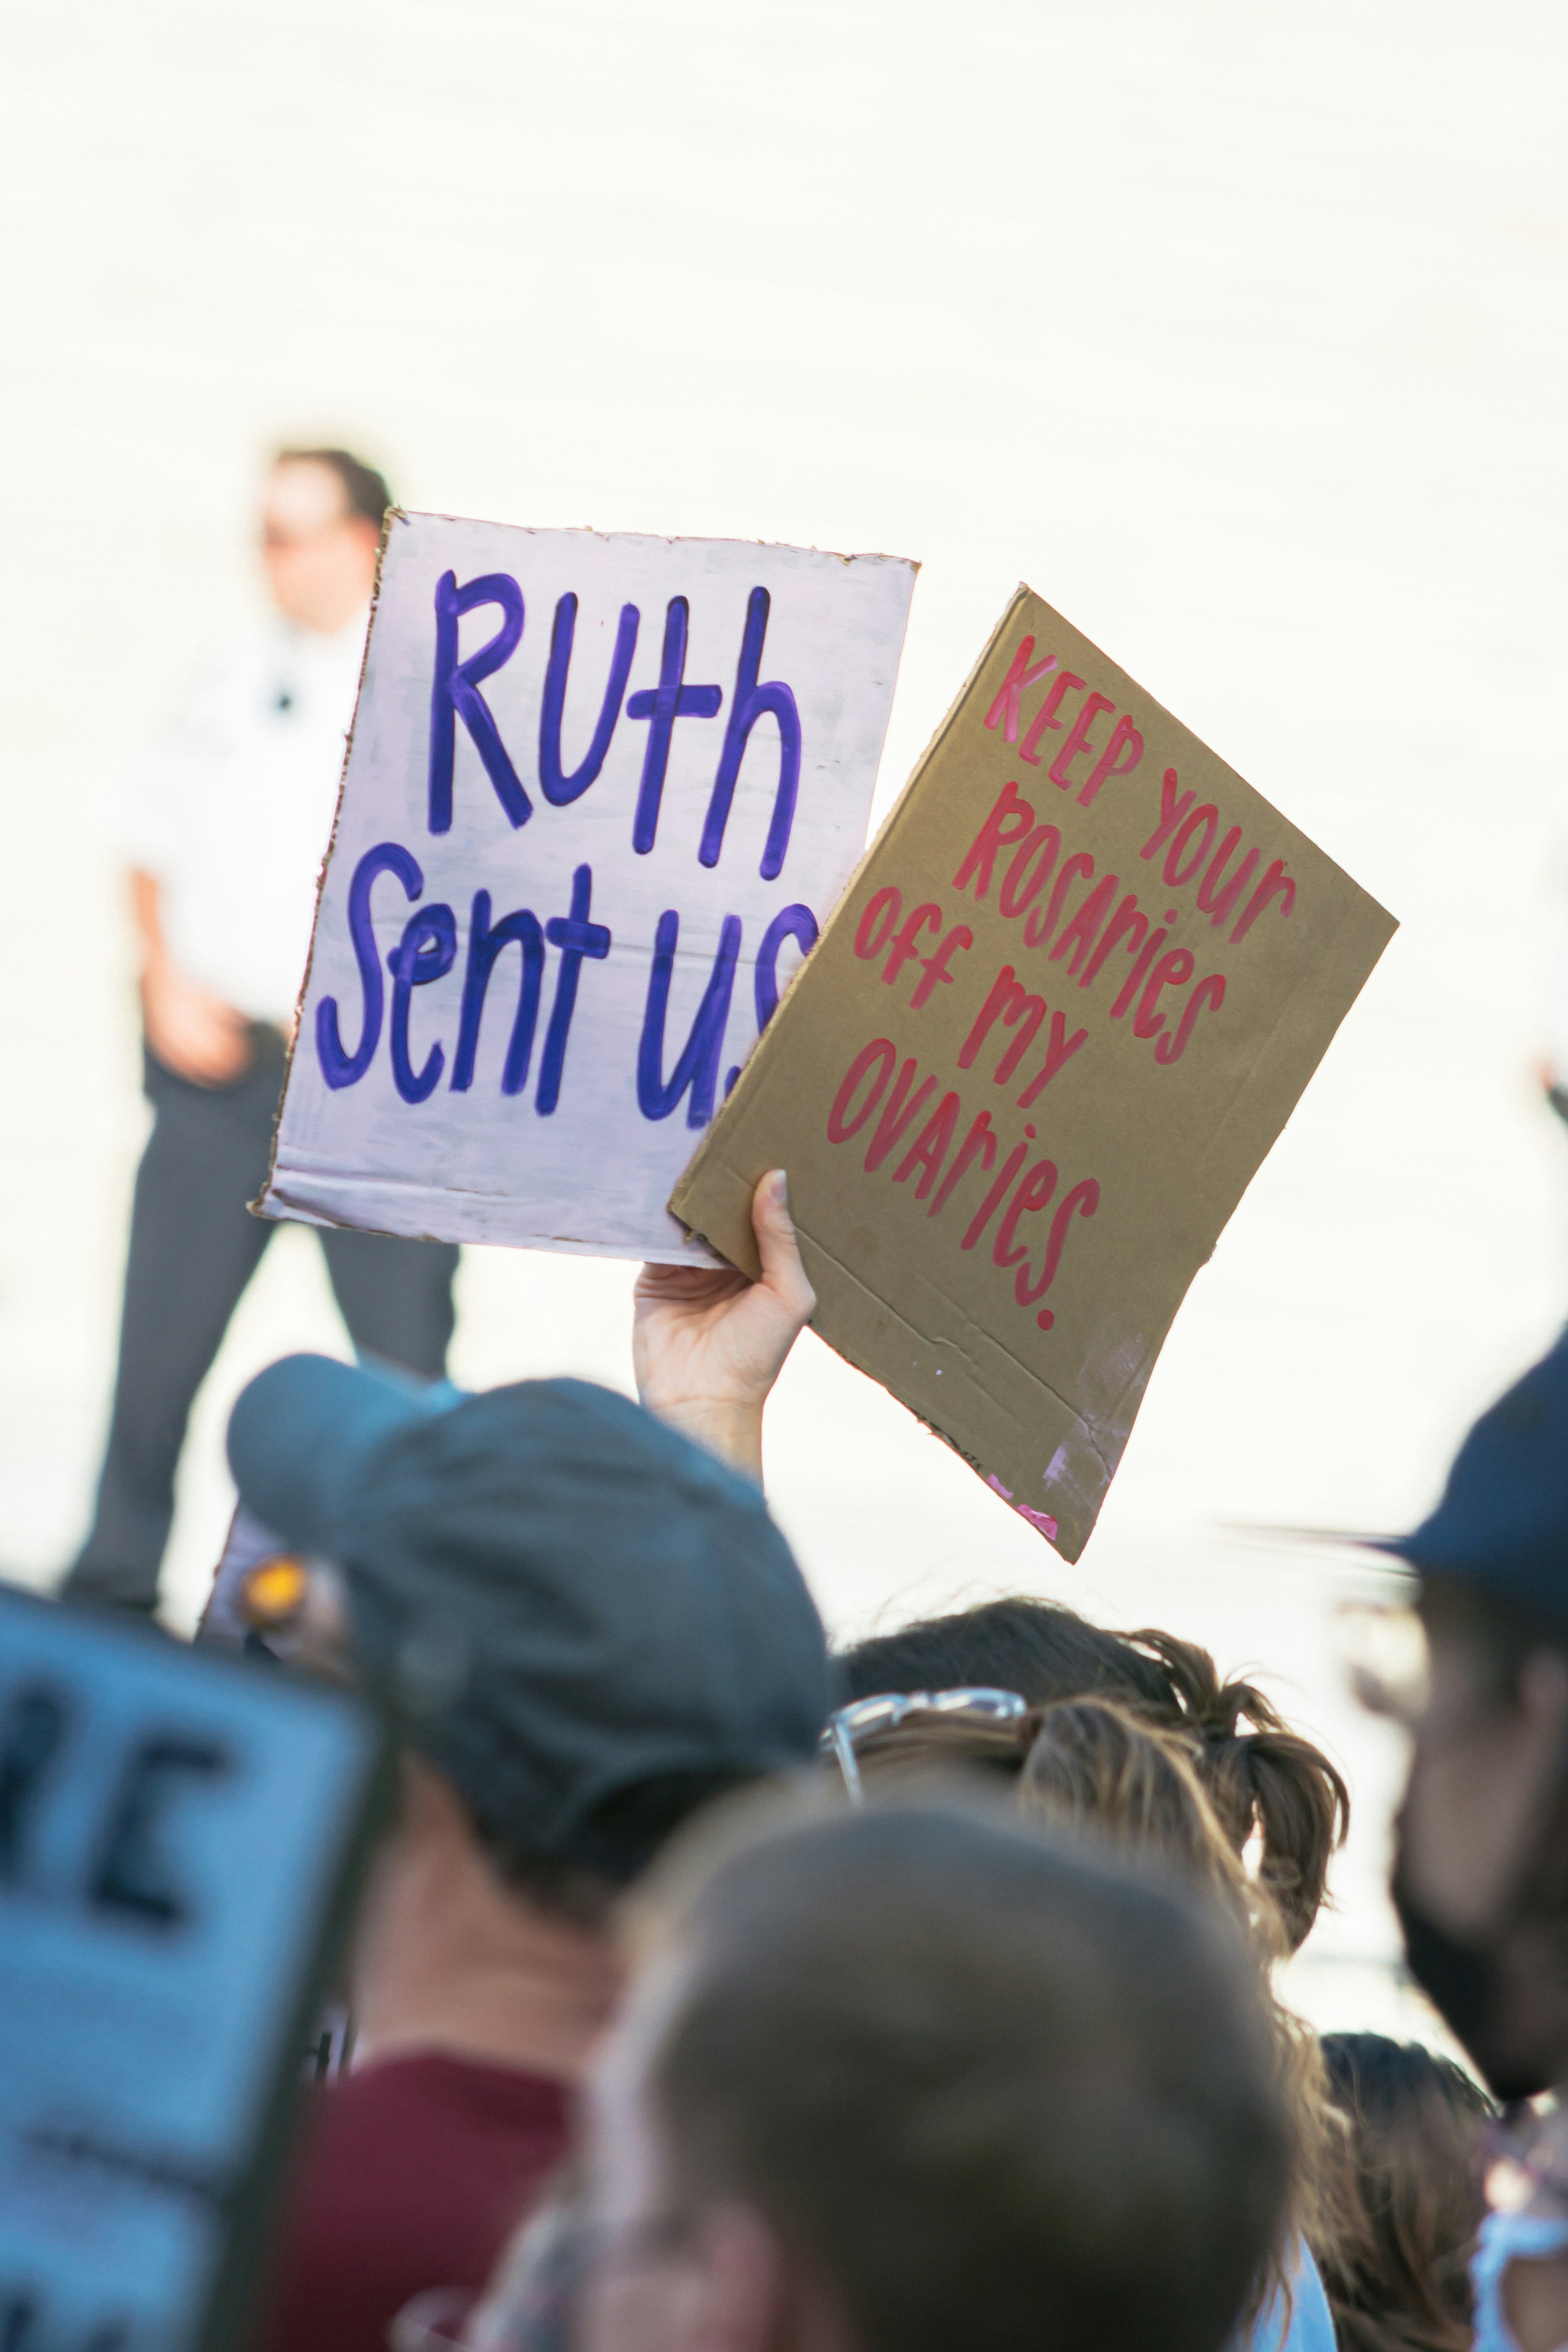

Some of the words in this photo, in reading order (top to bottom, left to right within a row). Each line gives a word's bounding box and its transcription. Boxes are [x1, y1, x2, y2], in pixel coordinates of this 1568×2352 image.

[983, 635, 1144, 808] KEEP
[316, 842, 611, 1117] Sent
[854, 886, 973, 1010] off
